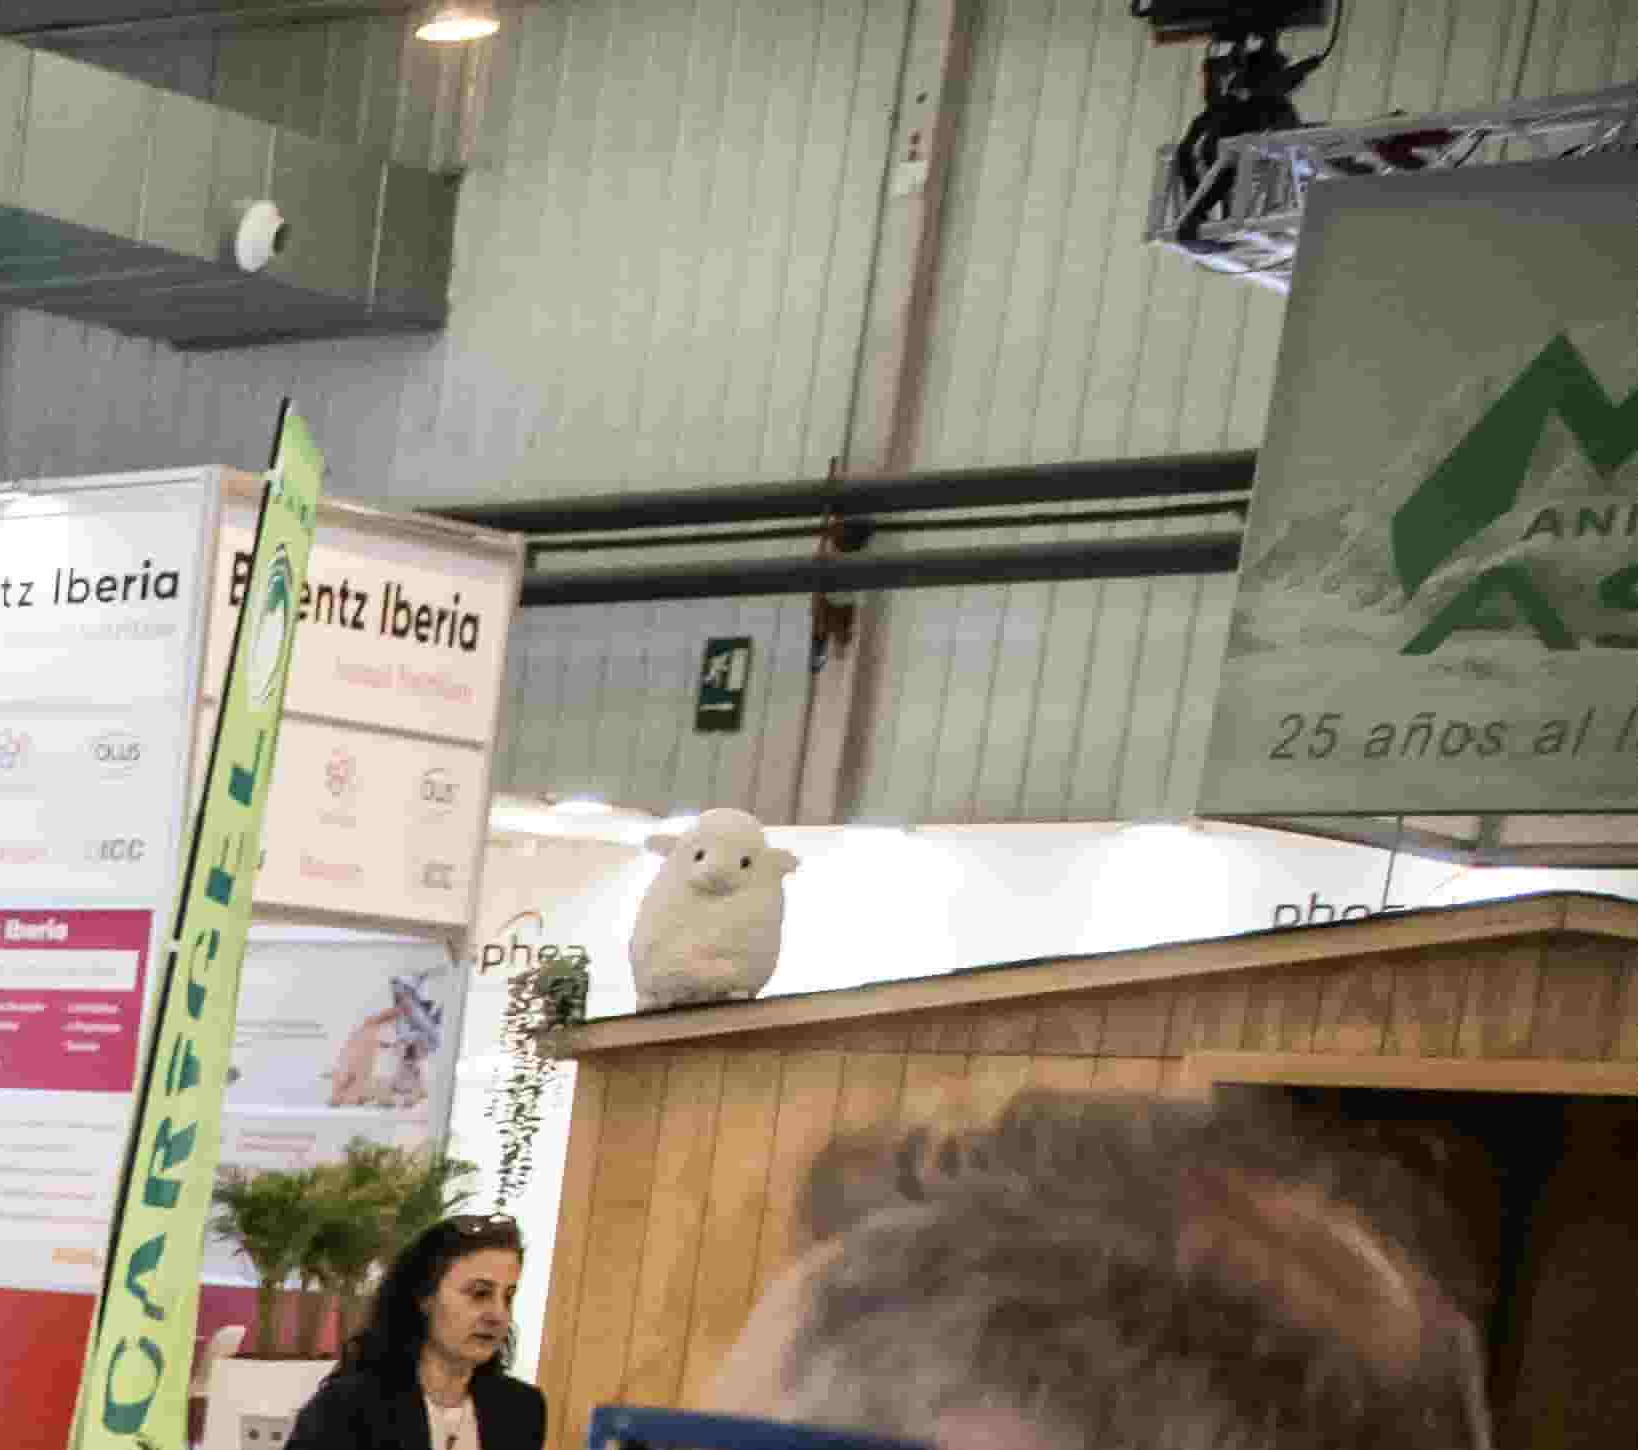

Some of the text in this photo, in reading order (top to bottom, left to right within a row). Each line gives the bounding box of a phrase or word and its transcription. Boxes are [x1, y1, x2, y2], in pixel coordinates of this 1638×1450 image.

[53, 558, 181, 607] Iberia
[379, 580, 481, 652] Iberia
[1270, 713, 1341, 762] 25
[1364, 712, 1509, 760] años
[1533, 707, 1597, 757] al
